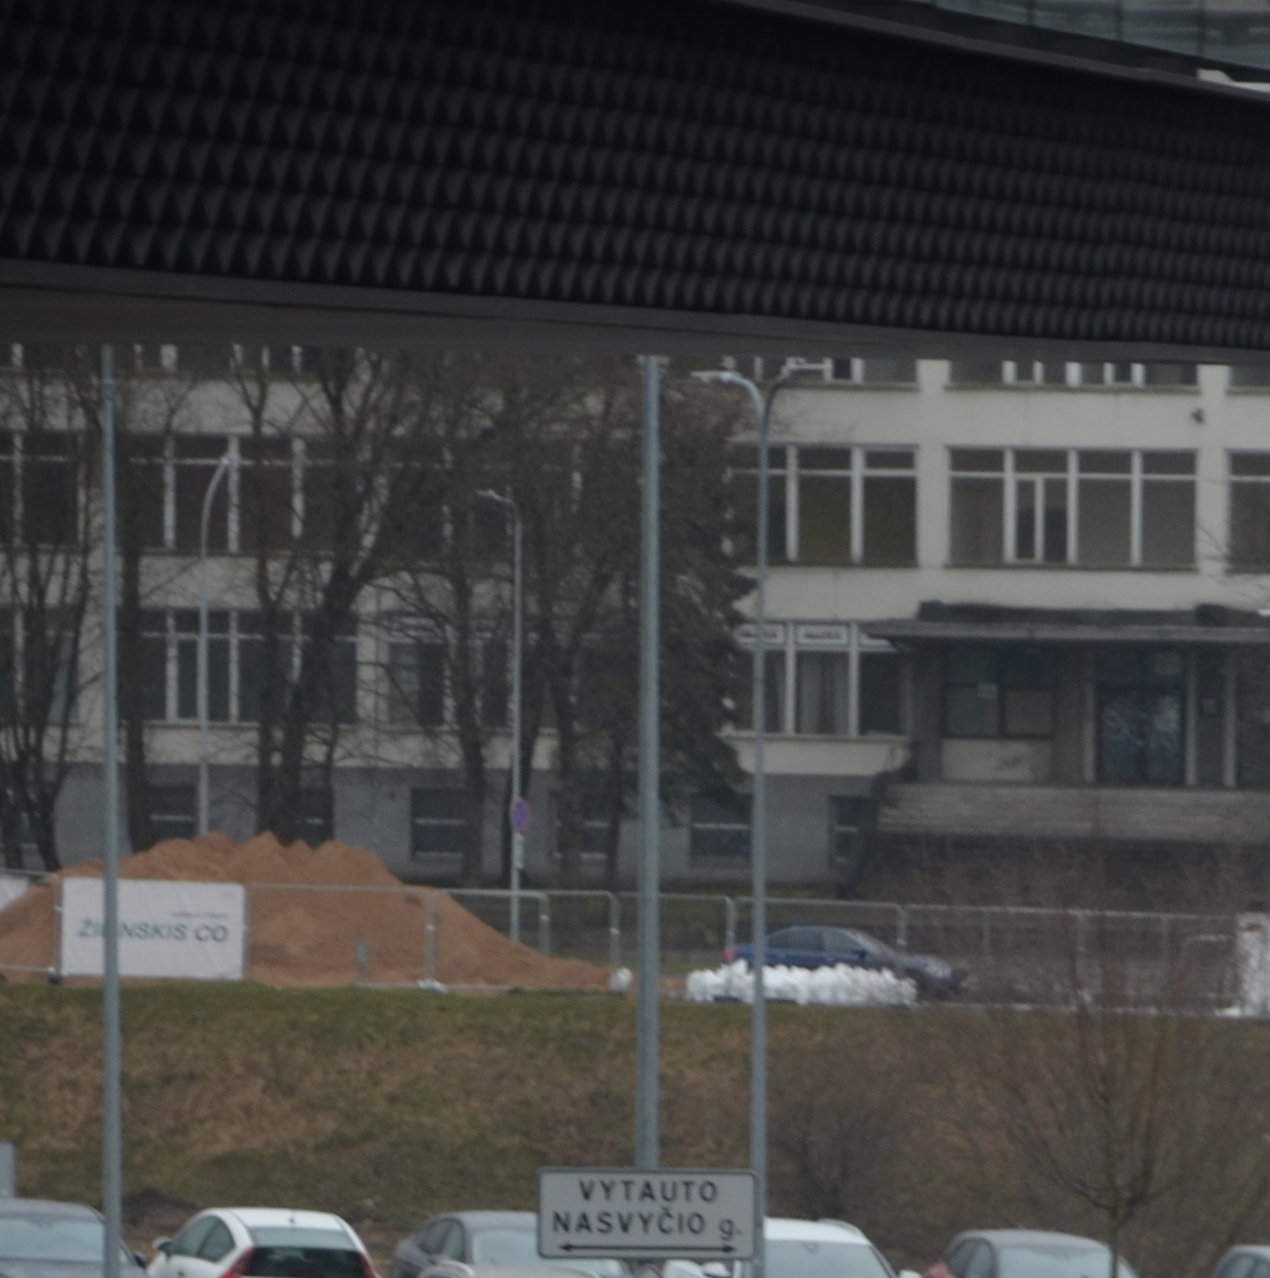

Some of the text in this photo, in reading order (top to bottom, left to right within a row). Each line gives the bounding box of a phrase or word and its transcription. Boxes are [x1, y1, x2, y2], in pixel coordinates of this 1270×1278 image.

[194, 924, 229, 942] CO
[578, 1179, 718, 1202] VYTAUTO
[552, 1206, 743, 1241] NASVYČIO g.
